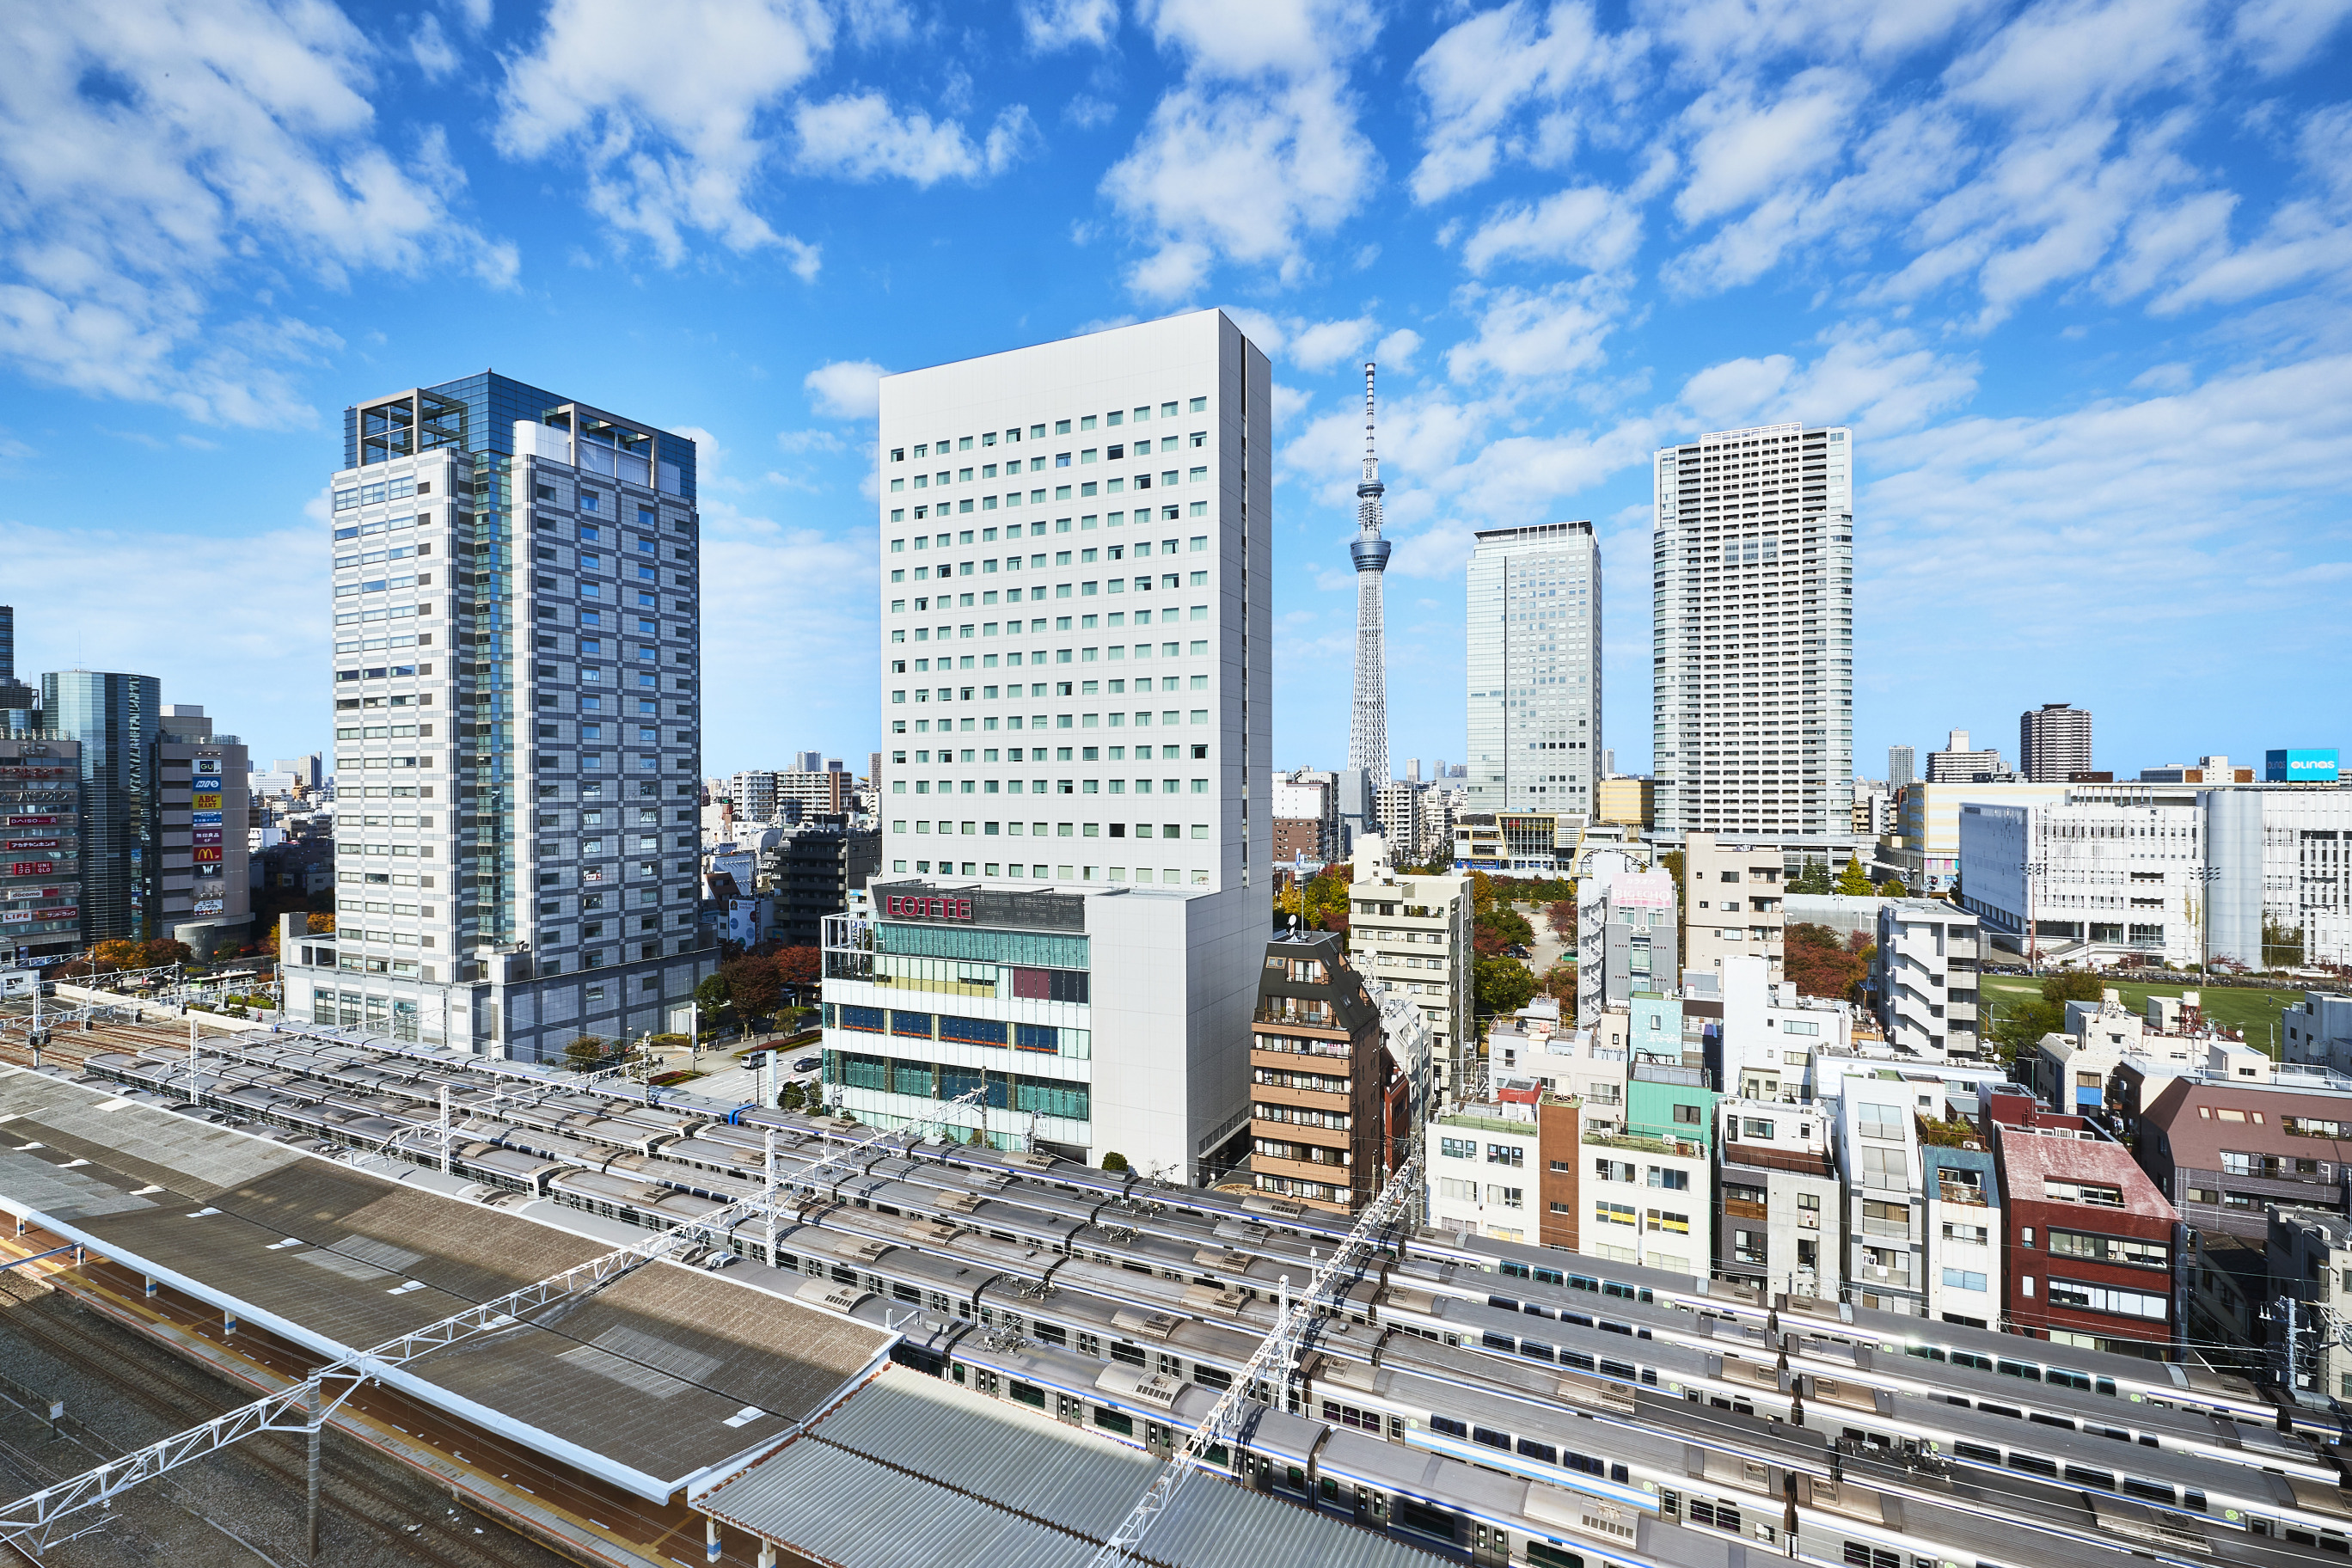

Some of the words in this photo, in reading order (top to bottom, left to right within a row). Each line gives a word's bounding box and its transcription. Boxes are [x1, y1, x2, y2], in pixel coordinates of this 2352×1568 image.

[1613, 889, 1635, 899] BIG
[1637, 890, 1670, 902] ECHO
[886, 895, 971, 919] LOTTE
